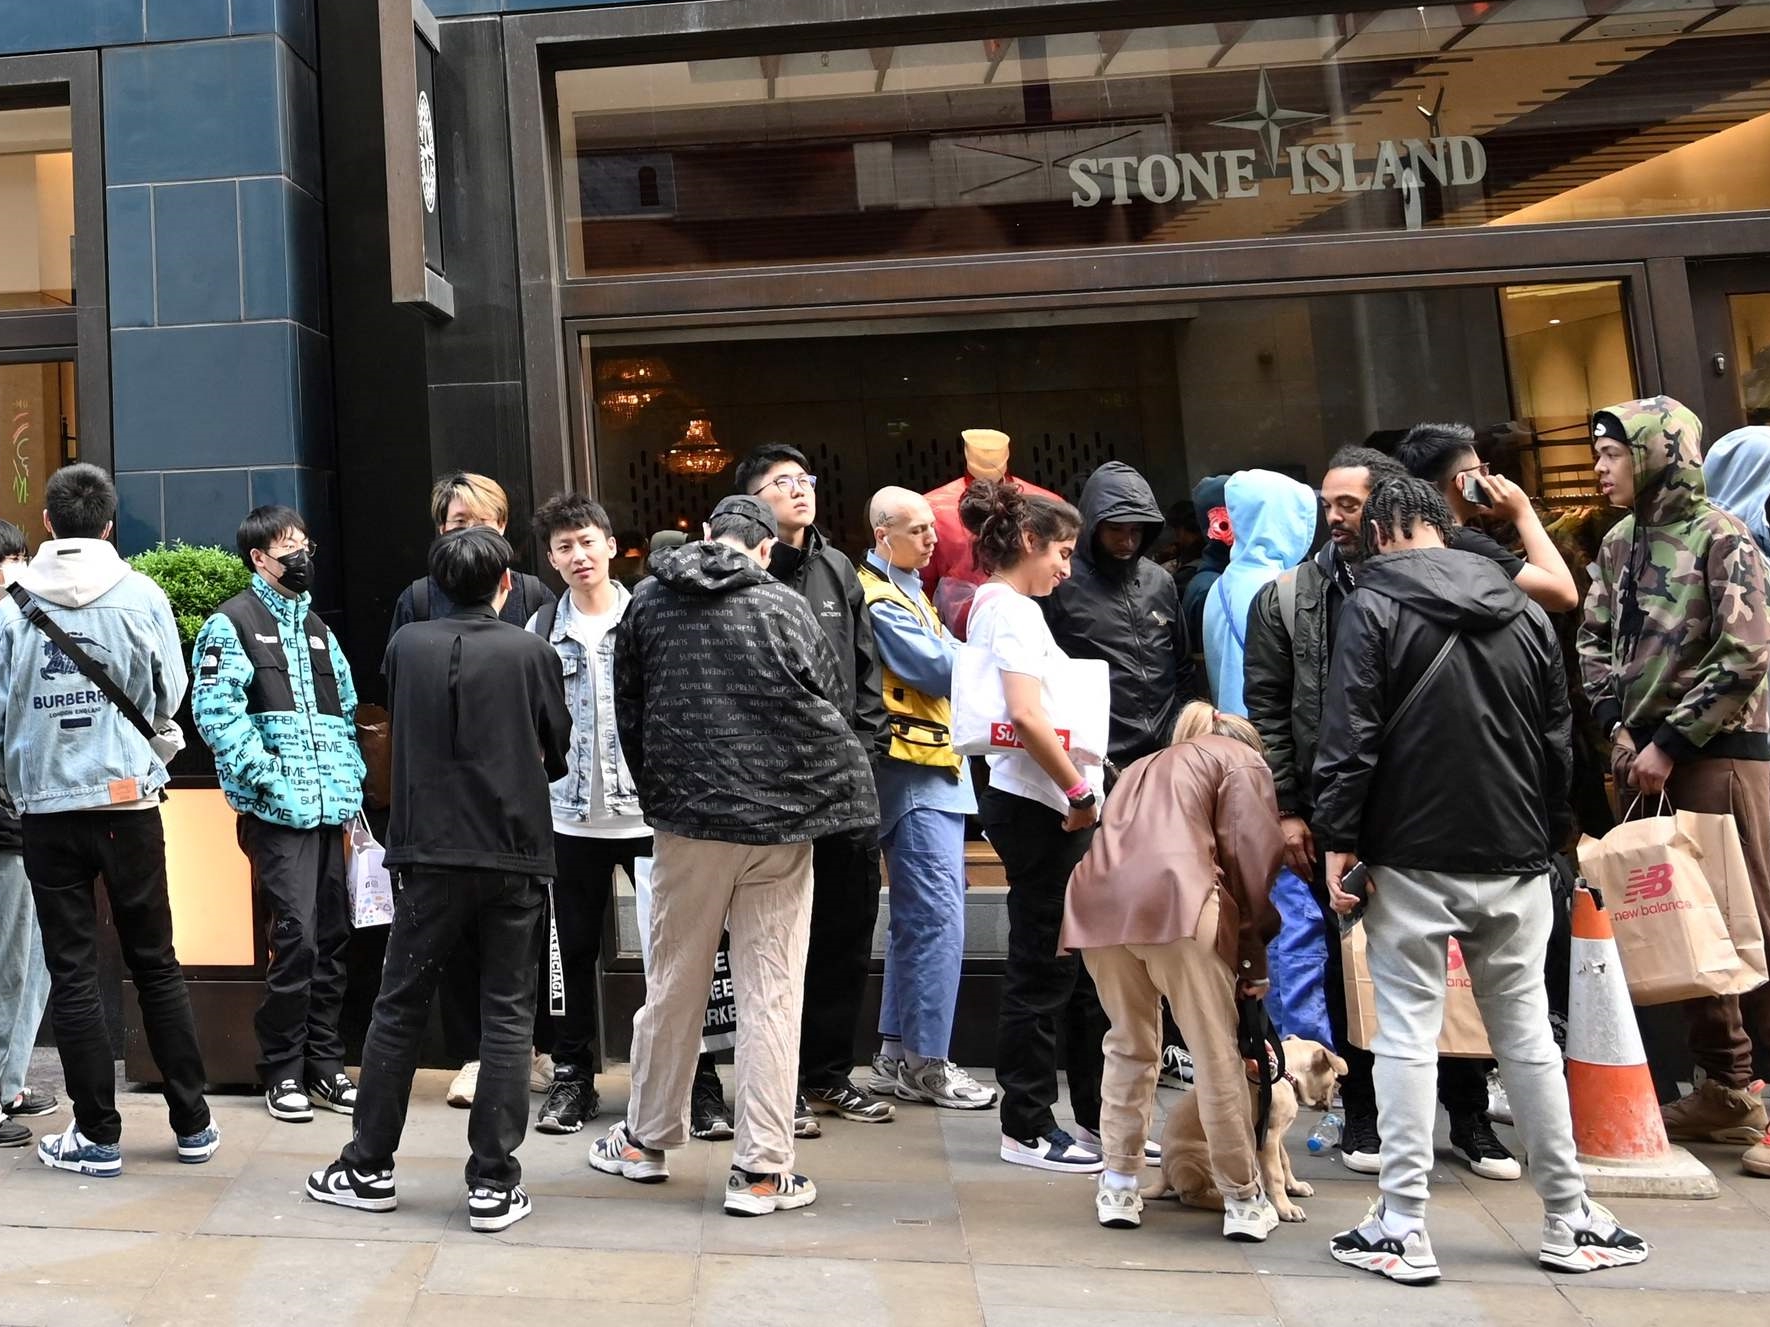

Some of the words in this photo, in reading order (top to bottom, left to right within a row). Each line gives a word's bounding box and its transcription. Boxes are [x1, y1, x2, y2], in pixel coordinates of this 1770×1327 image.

[1068, 148, 1260, 208] STONE
[1285, 135, 1488, 196] ISLAND
[33, 690, 110, 710] BURBERR
[1614, 908, 1640, 921] new
[1641, 898, 1693, 916] balance
